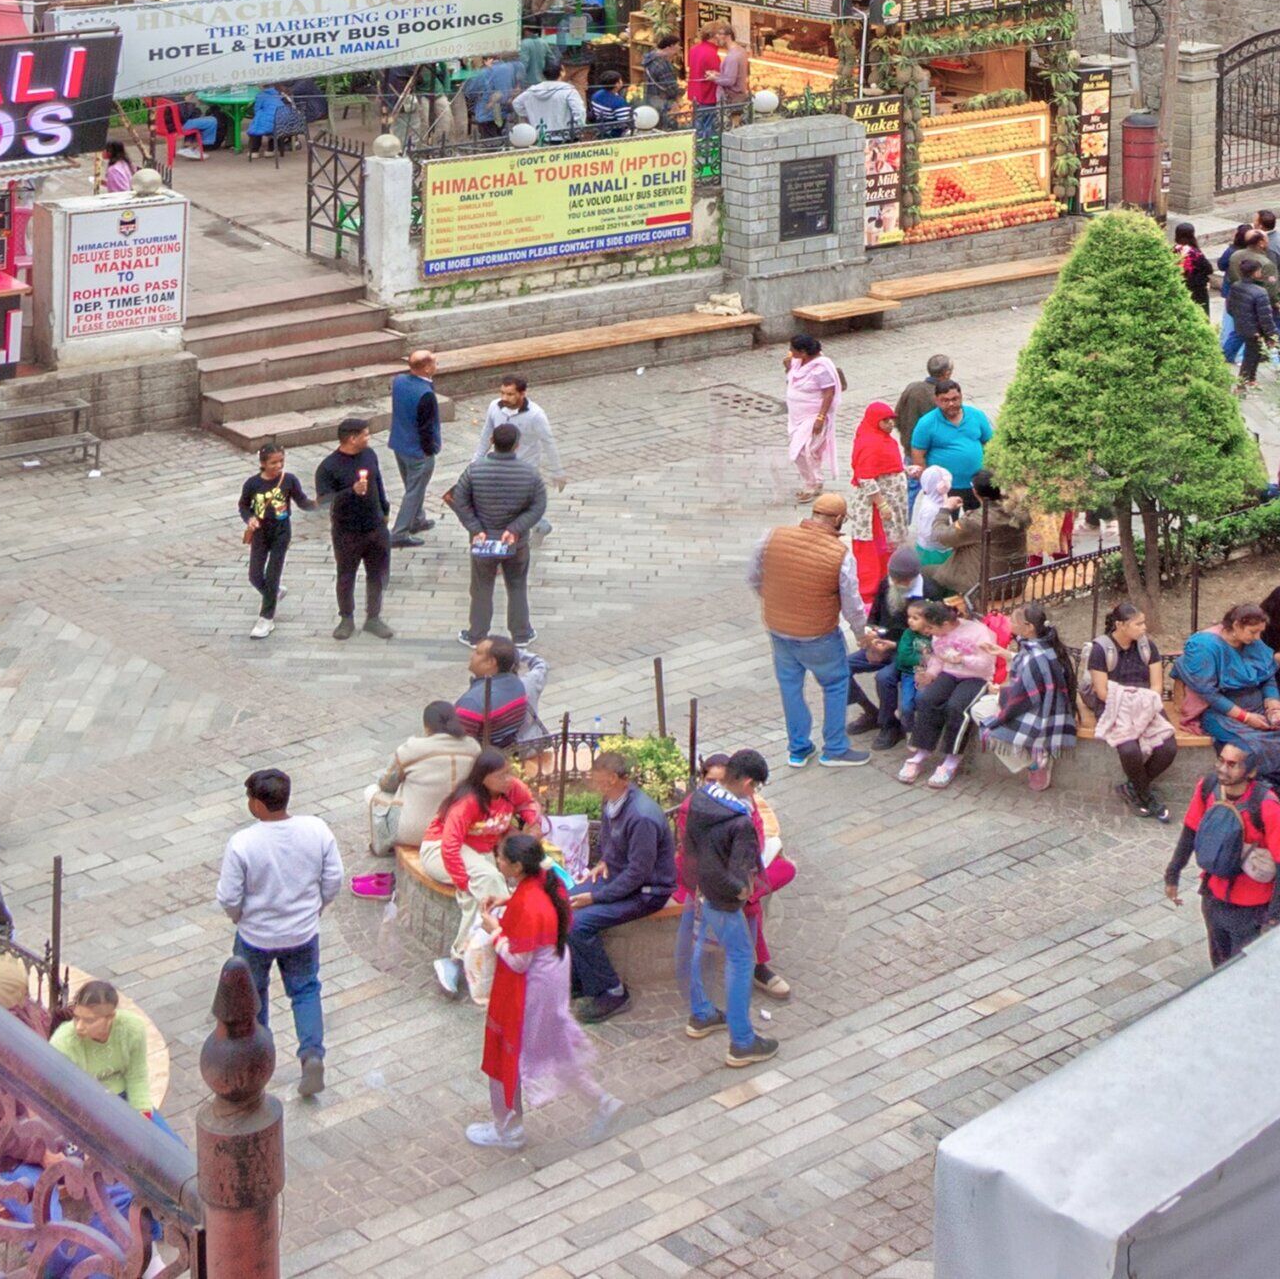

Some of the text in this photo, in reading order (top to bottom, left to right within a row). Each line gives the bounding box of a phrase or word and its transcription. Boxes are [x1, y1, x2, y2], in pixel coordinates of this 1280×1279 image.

[205, 2, 458, 40] THE MARKETING OFFICE
[148, 12, 504, 62] HOTEL & LUXURY BUS BOOKINGS
[253, 51, 285, 64] THE
[291, 44, 334, 61] MALL
[340, 37, 400, 55] MANALI
[854, 101, 900, 118] Kit Kat
[516, 147, 614, 168] (GOVT. OF HIMACHAL)
[431, 151, 688, 196] HIMACHAL TOURISM (HPTDC)
[568, 177, 628, 197] MANALI
[642, 170, 686, 187] DELHI
[877, 173, 899, 185] Milk
[459, 188, 513, 203] DAILY TOUR
[568, 185, 687, 212] (A/C VOLVO DAILY BUS SERVICE)
[597, 208, 615, 216] BOOK
[616, 205, 633, 213] ALSO
[634, 202, 657, 211] ONLINE
[658, 199, 674, 207] WITH
[72, 241, 181, 265] DELUXE BUS BOOKING
[77, 234, 178, 252] HIMACHAL TOURISM
[429, 226, 687, 272] FOR MORE INFORMATION PLEASE CONTACT IN SIDE OFFICE COUNTER
[94, 256, 160, 274] MANALI
[117, 271, 135, 283] TO
[73, 278, 179, 301] ROHTANG PASS
[74, 301, 103, 314] DEP.
[72, 312, 178, 334] PLEASE CONTACT IN SIDE
[76, 313, 103, 324] FOR
